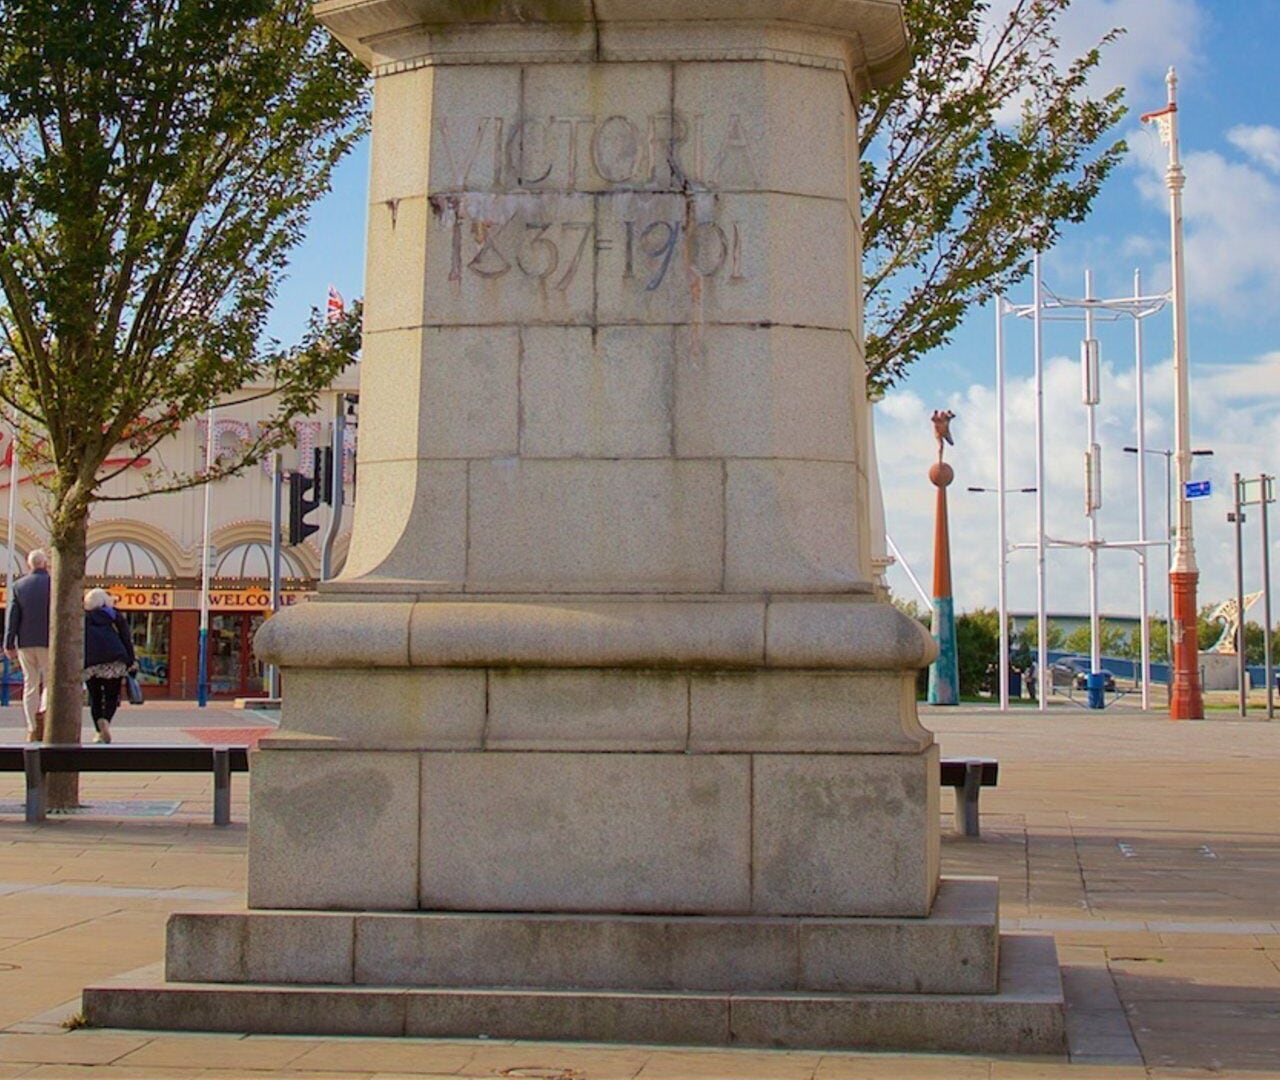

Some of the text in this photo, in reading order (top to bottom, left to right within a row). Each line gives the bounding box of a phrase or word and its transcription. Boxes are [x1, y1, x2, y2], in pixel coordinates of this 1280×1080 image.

[439, 111, 762, 192] VICTORIA
[127, 593, 147, 605] TO
[149, 593, 168, 606] £1
